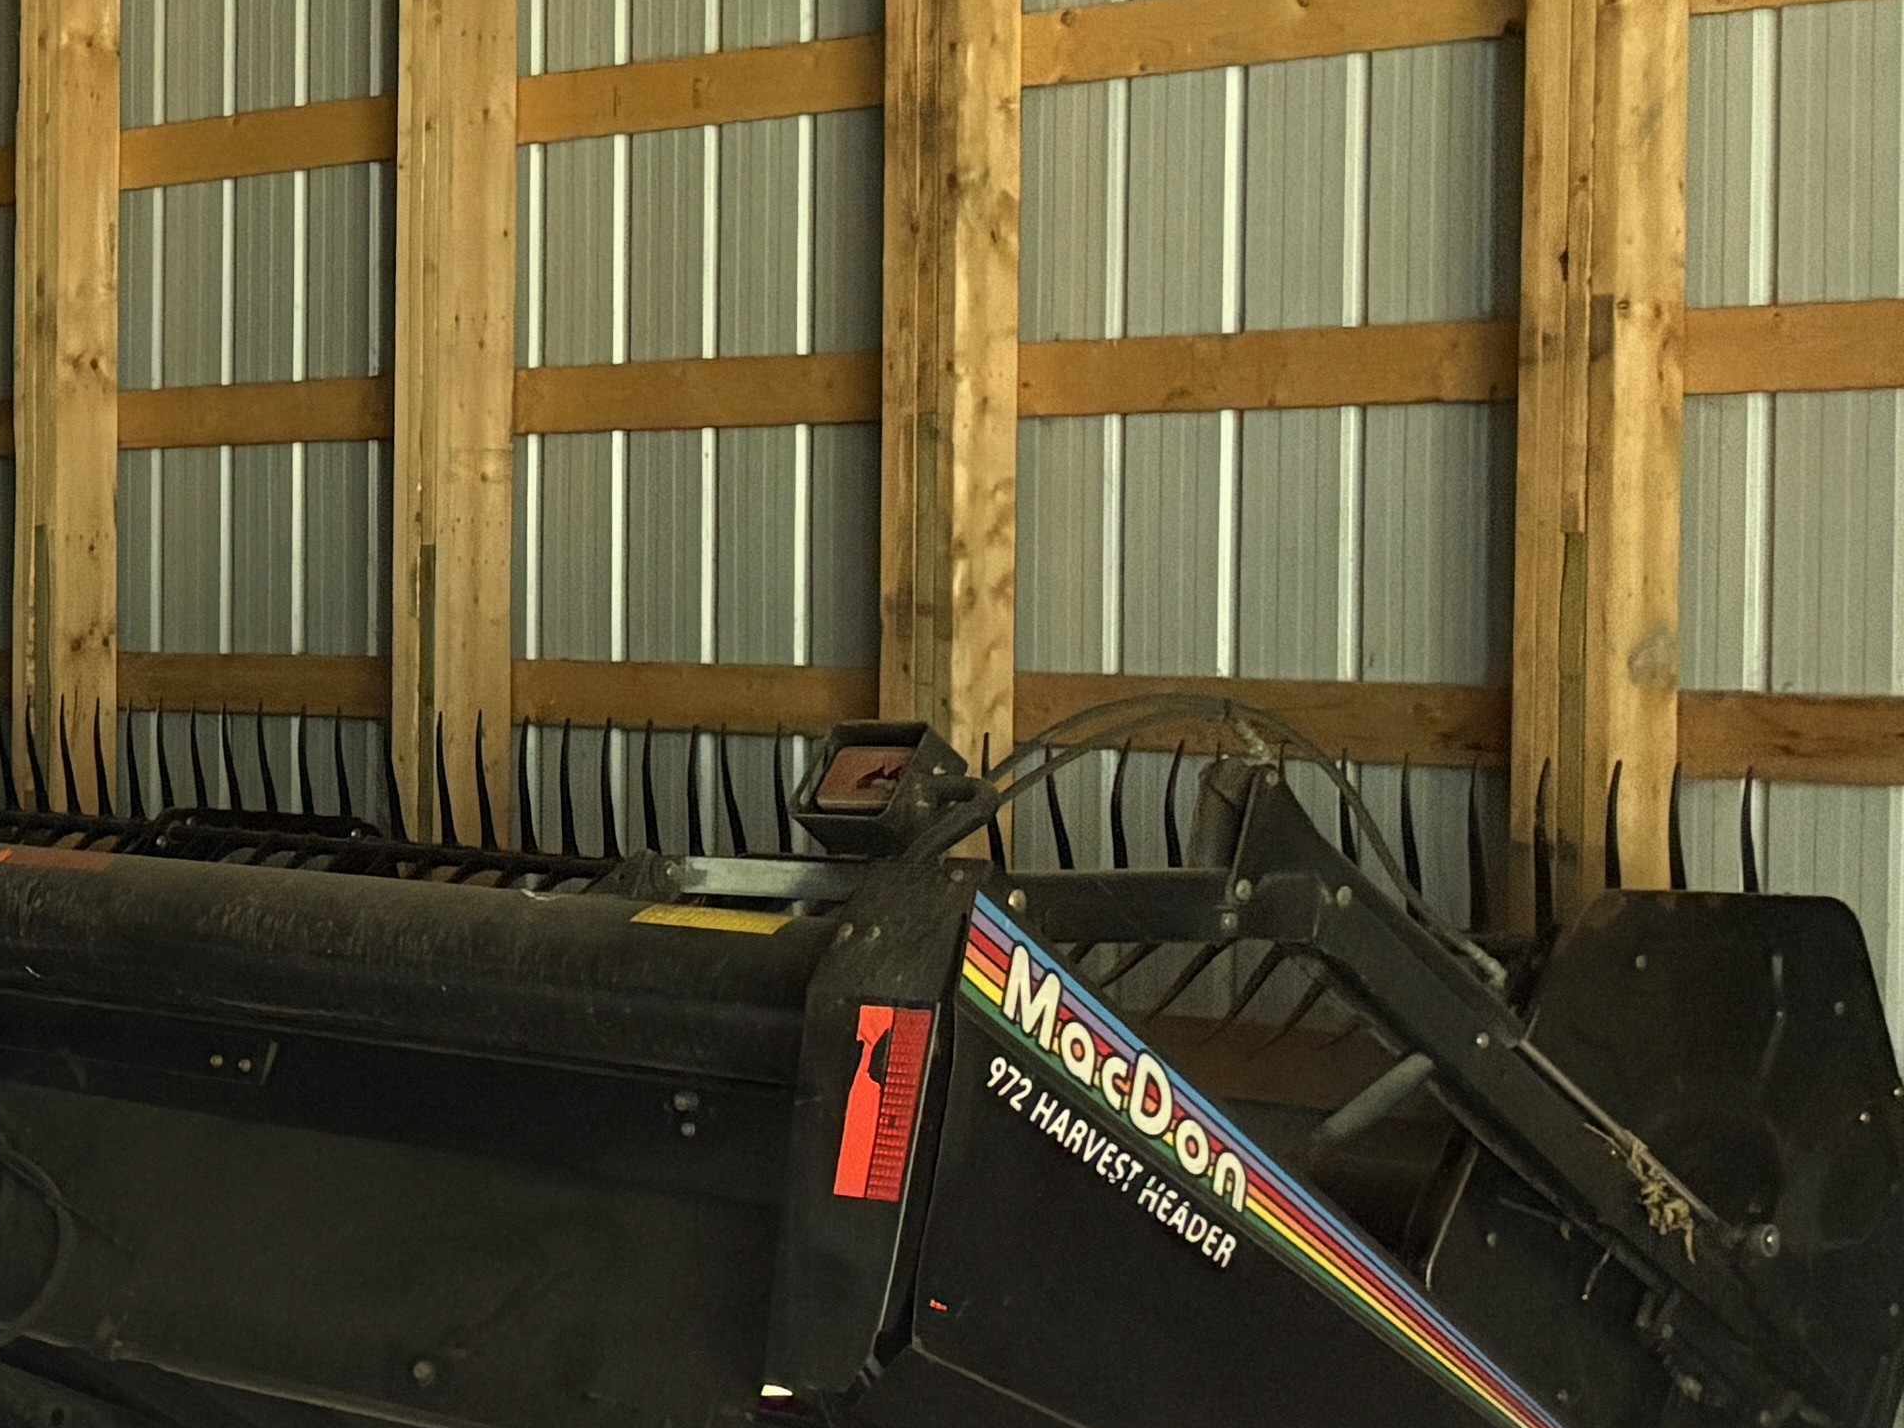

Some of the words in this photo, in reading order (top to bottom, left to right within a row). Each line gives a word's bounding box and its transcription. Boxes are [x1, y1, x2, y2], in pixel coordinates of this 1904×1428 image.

[987, 1056, 1033, 1112] 972
[1029, 1091, 1144, 1193] HARVEST
[1136, 1175, 1238, 1269] HEADER
[1003, 945, 1247, 1213] MacDon
